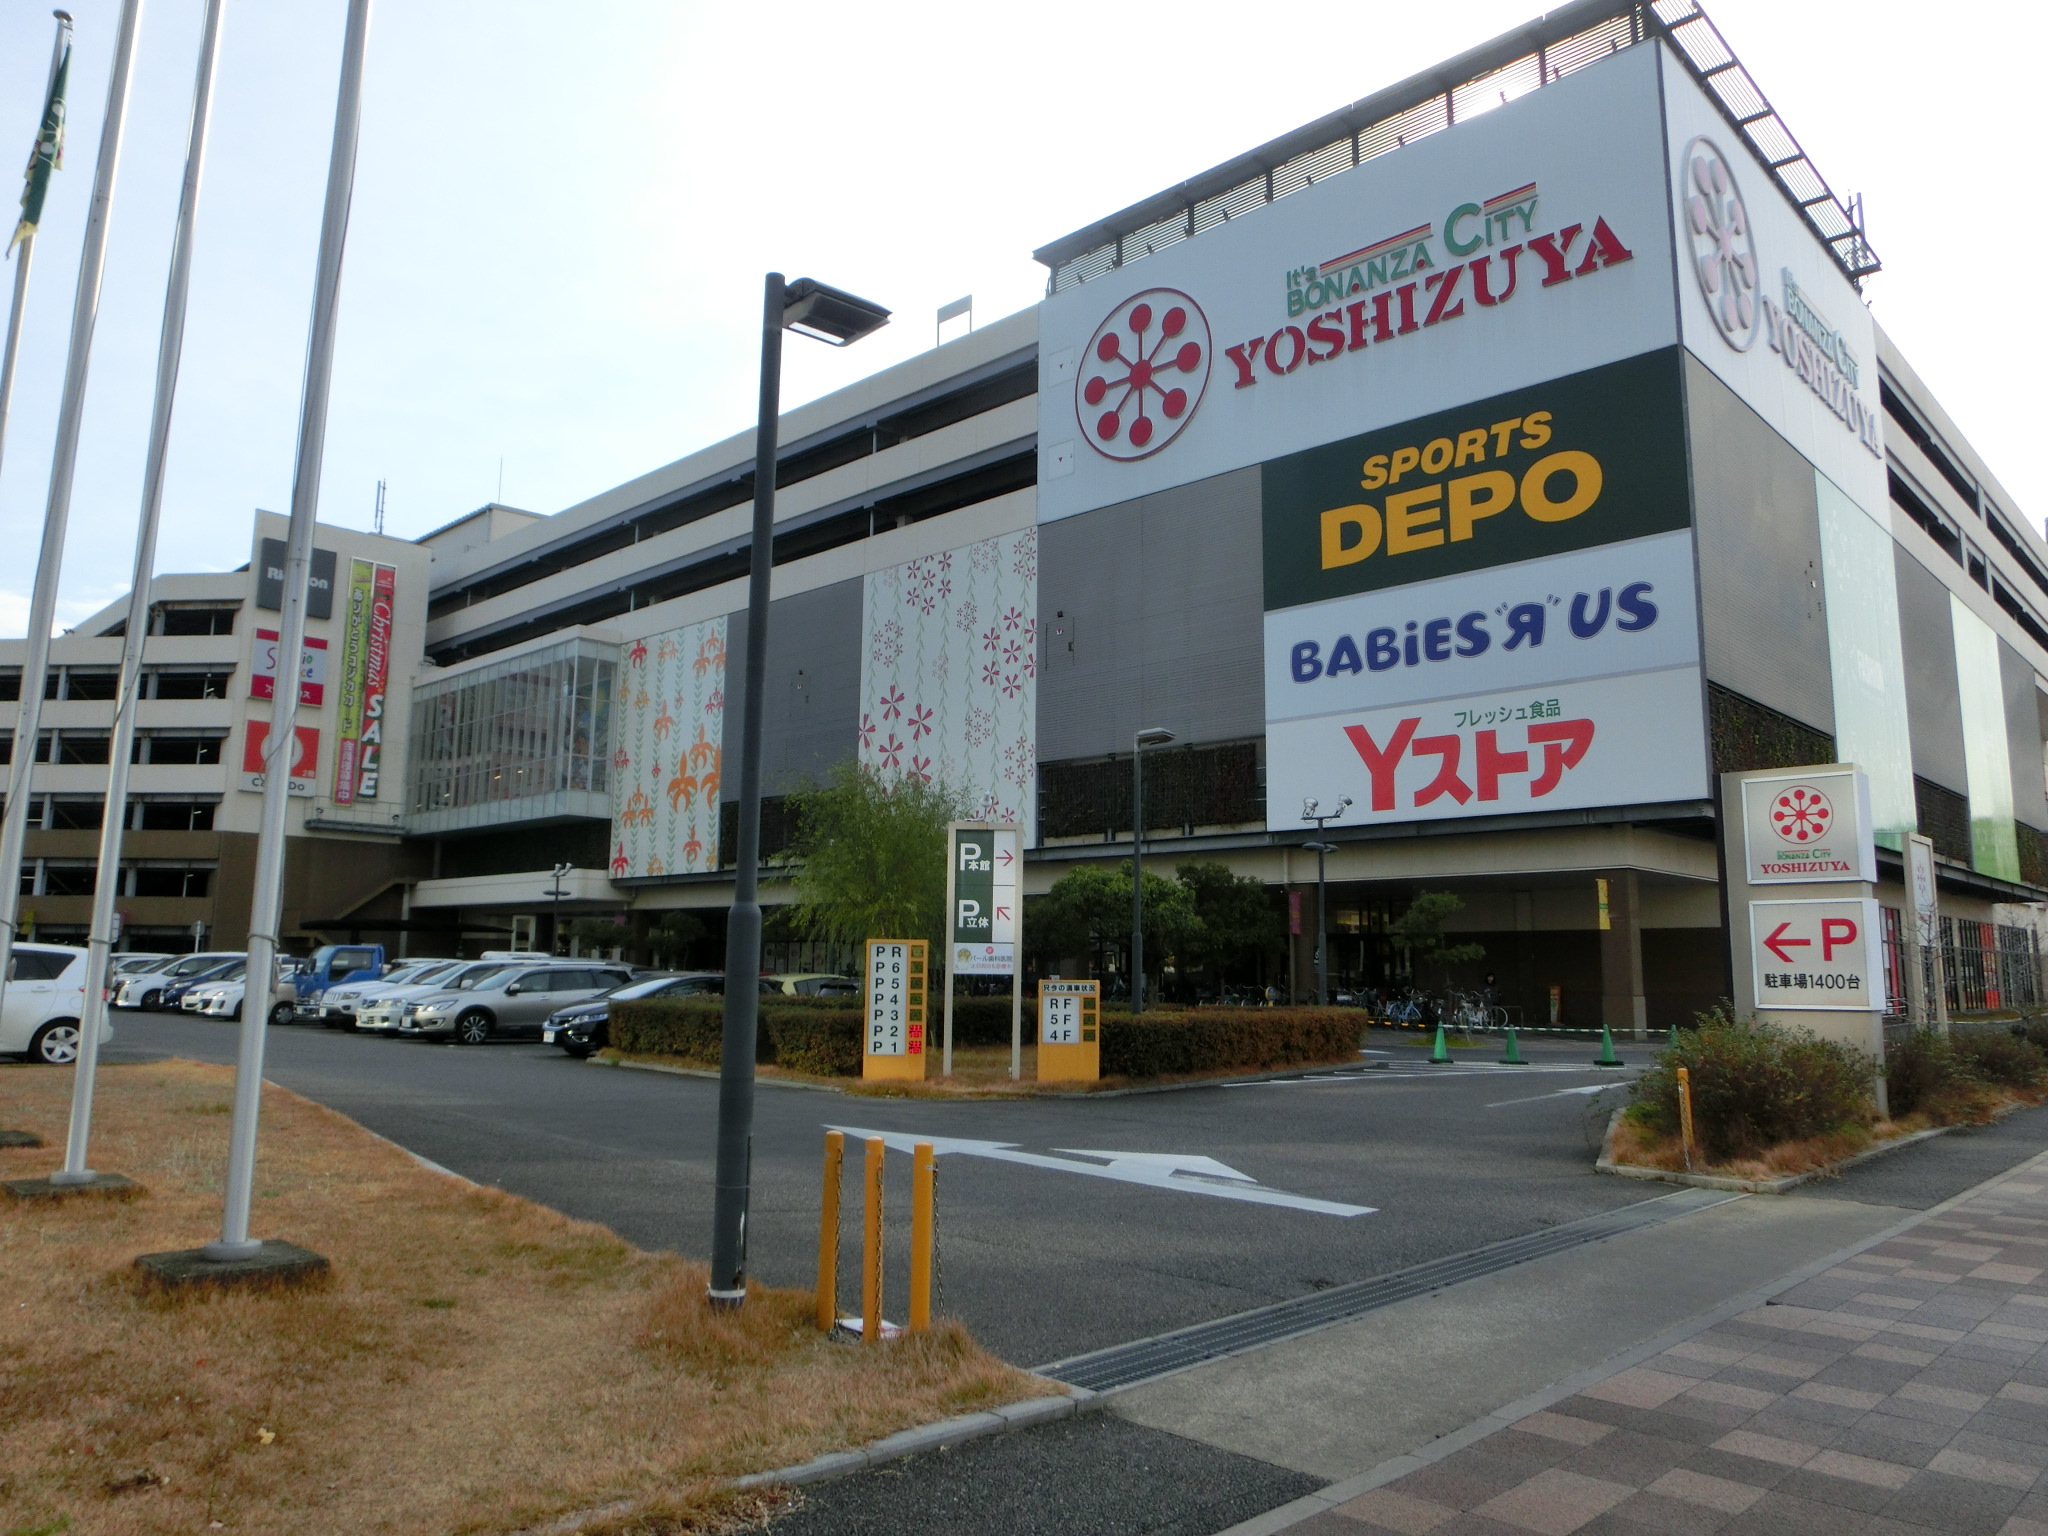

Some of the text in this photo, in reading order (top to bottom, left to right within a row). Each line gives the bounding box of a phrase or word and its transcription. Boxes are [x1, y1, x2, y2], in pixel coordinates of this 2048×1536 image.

[1226, 215, 1633, 388] YOSHIZUYA
[1286, 264, 1319, 291] It's
[1287, 202, 1538, 318] BONANZA CITY
[1360, 410, 1553, 491] SPORTS
[1320, 449, 1603, 571] DEPO
[368, 602, 391, 688] Christmas
[358, 694, 384, 796] SALE
[1454, 698, 1562, 728] フレッシュ食品
[1343, 716, 1596, 812] Yストア
[1761, 860, 1850, 875] YOSHIZUYA
[1821, 918, 1858, 961] P
[1764, 973, 1861, 990] 駐車場1400台
